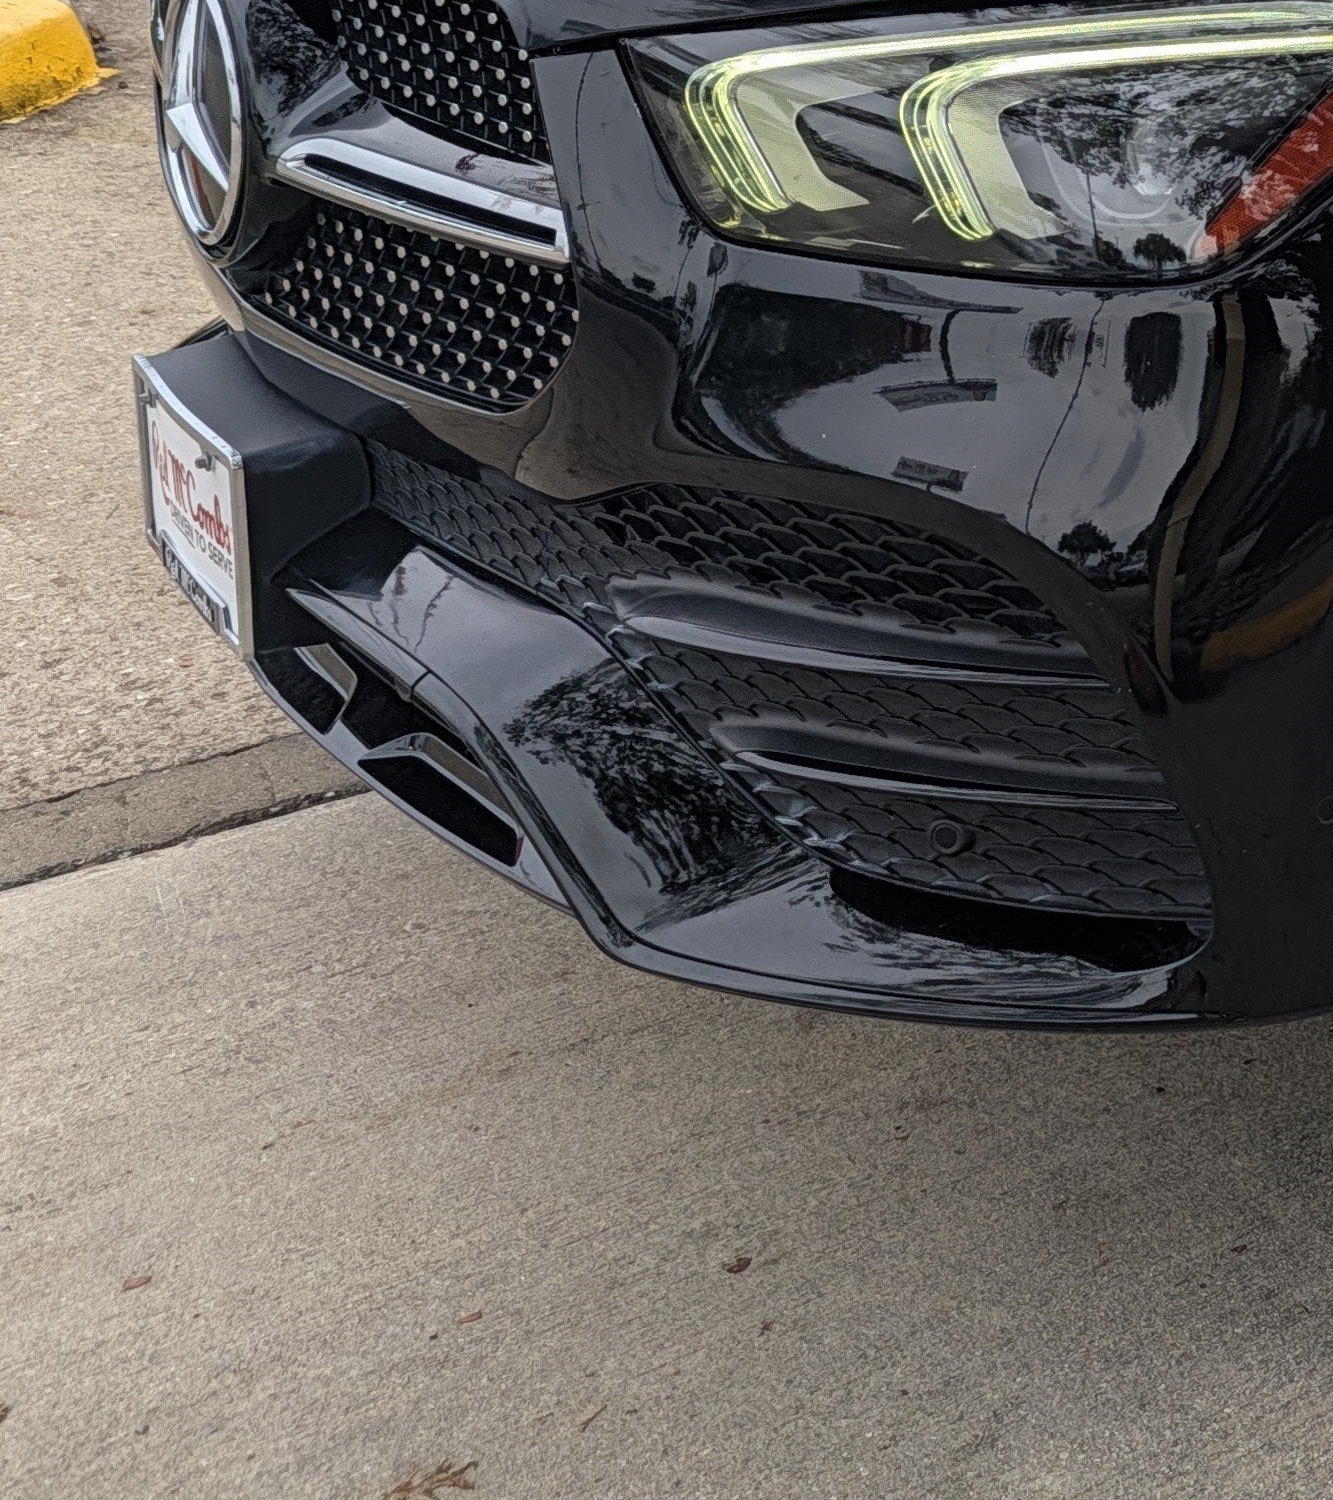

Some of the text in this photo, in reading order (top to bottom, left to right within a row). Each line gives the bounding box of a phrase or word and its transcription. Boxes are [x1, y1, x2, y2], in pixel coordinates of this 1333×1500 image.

[151, 420, 171, 506] Red
[194, 528, 207, 554] TO
[208, 541, 234, 580] SERVE
